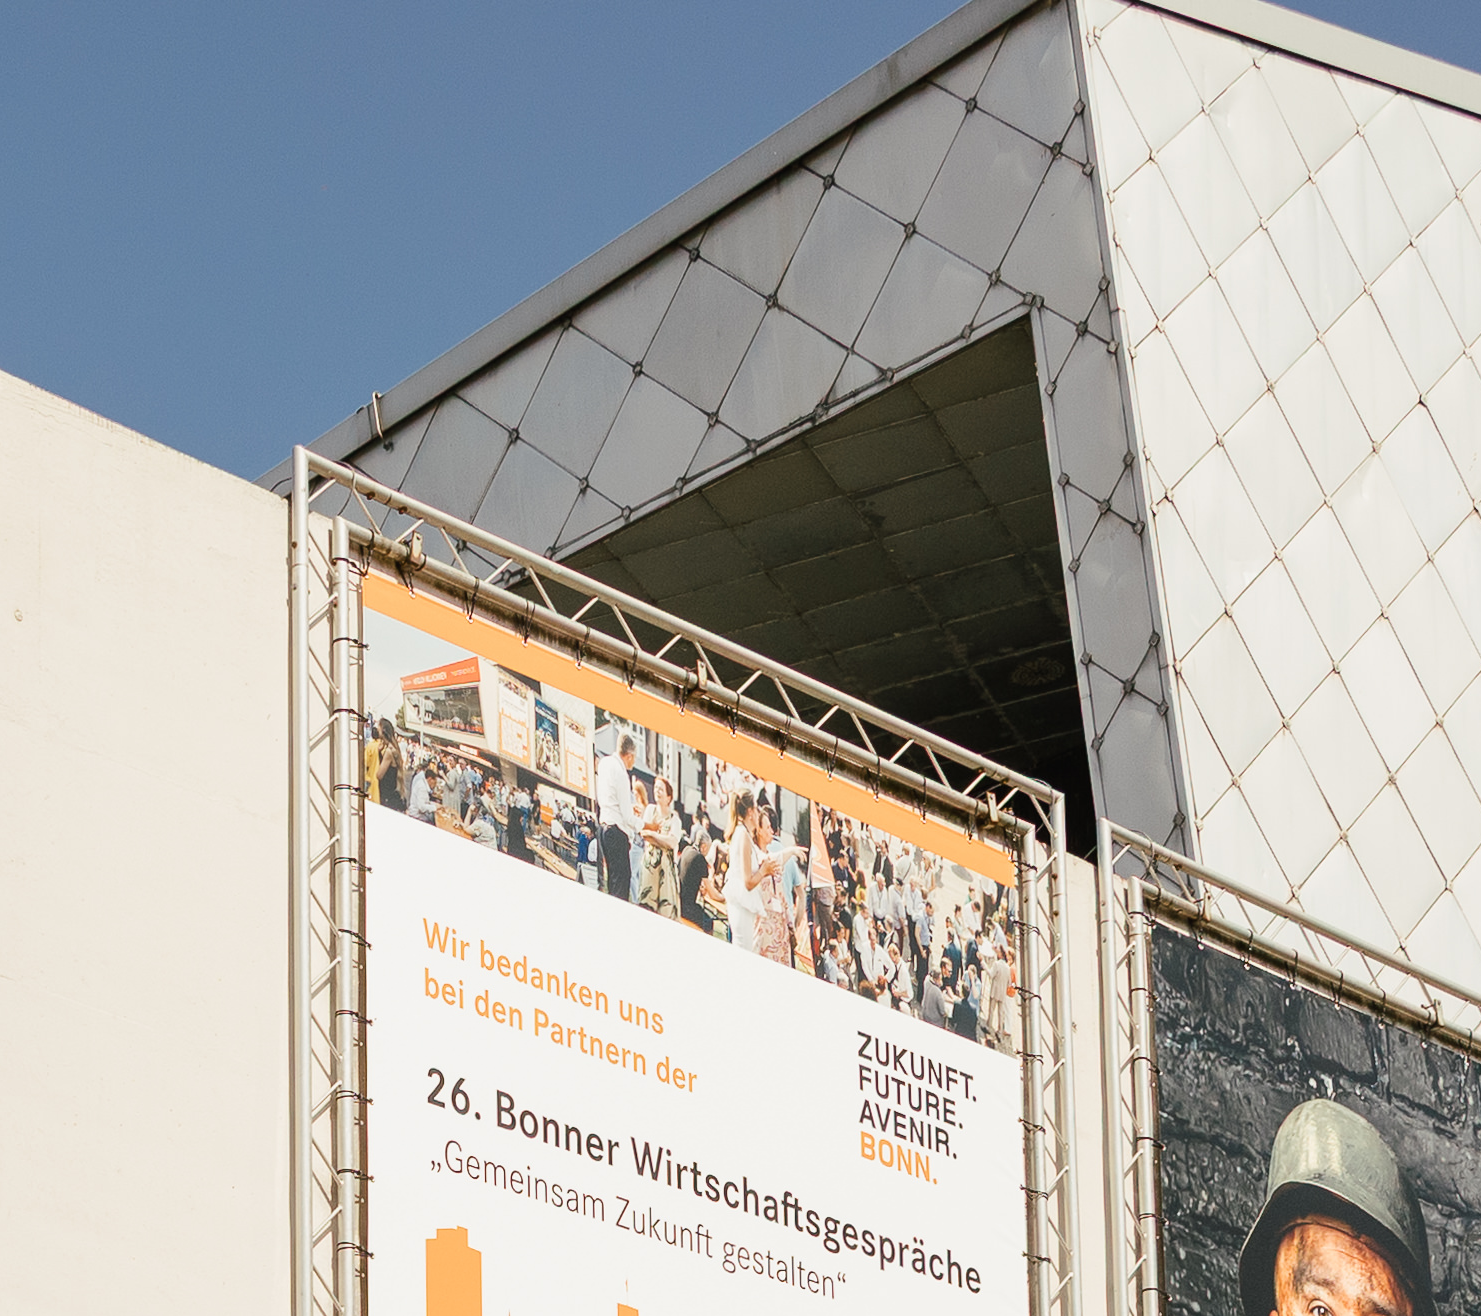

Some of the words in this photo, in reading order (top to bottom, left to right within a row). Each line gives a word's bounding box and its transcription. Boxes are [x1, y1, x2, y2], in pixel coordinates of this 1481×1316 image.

[424, 918, 469, 958] Wir
[480, 944, 610, 1012] bedanken
[619, 998, 664, 1035] uns
[425, 968, 464, 1010] bei
[475, 986, 524, 1031] den
[534, 1011, 647, 1076] Partnern
[656, 1051, 698, 1093] der
[858, 1031, 977, 1102] ZUKUNFT.
[859, 1064, 963, 1129] FUTURE.
[860, 1098, 957, 1159] AVENIR.
[426, 1067, 481, 1121] 26.
[496, 1089, 620, 1167] Bonner
[631, 1136, 982, 1293] Wirtschaftsgespräche
[860, 1130, 938, 1185] BONN.
[431, 1140, 606, 1222] „Gemeinsam
[615, 1196, 713, 1259] Zukunft
[723, 1240, 846, 1300] gestalten“
